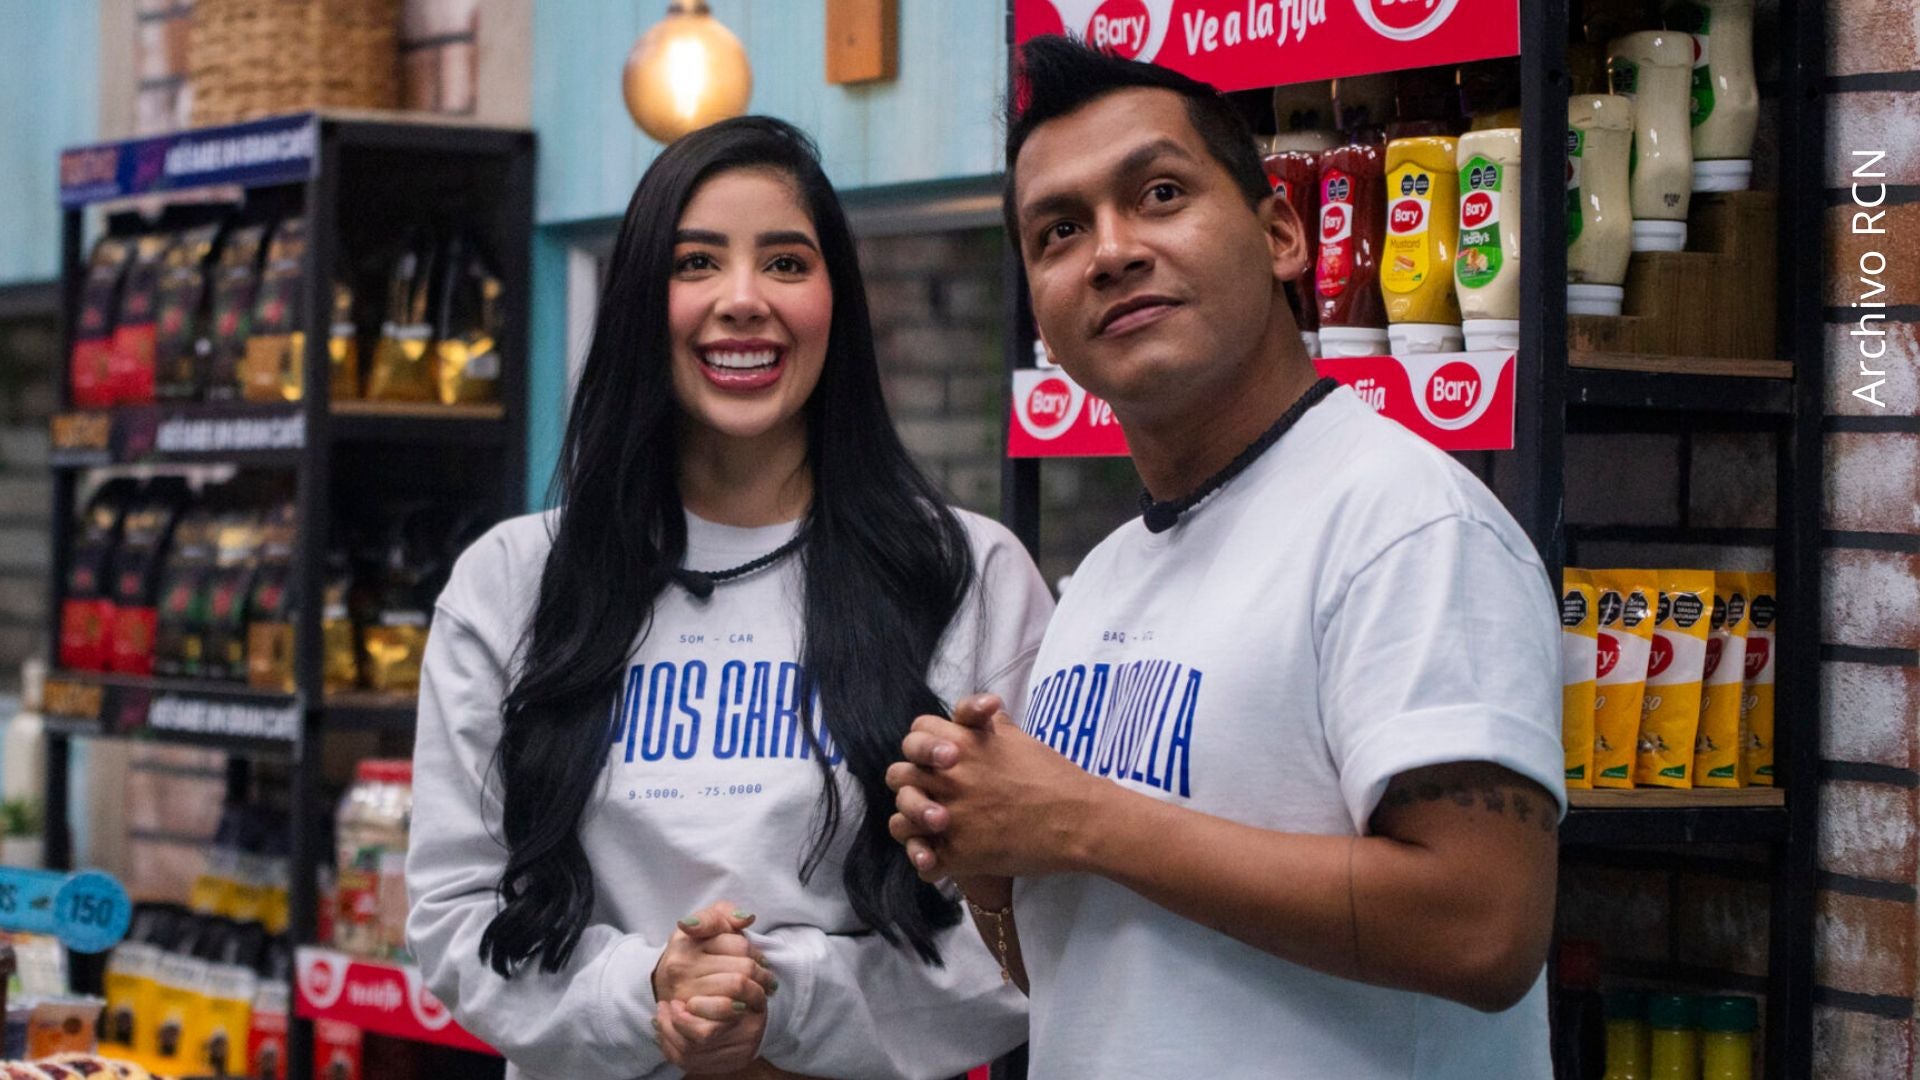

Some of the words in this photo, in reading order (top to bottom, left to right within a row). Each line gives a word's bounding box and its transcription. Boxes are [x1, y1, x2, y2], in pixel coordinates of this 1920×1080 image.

[1092, 14, 1146, 50] Bary
[1183, 11, 1217, 56] Ve
[1223, 20, 1240, 46] a
[1247, 1, 1275, 37] la
[1394, 208, 1419, 224] Bary
[1465, 202, 1488, 218] Bary
[1324, 215, 1343, 231] Bary
[1390, 238, 1420, 249] Mustard
[1432, 376, 1477, 407] Bary
[1031, 389, 1069, 419] Bary
[679, 633, 705, 644] SOM
[729, 633, 754, 644] CAR
[1102, 630, 1126, 644] BAQ
[70, 893, 114, 929] 150
